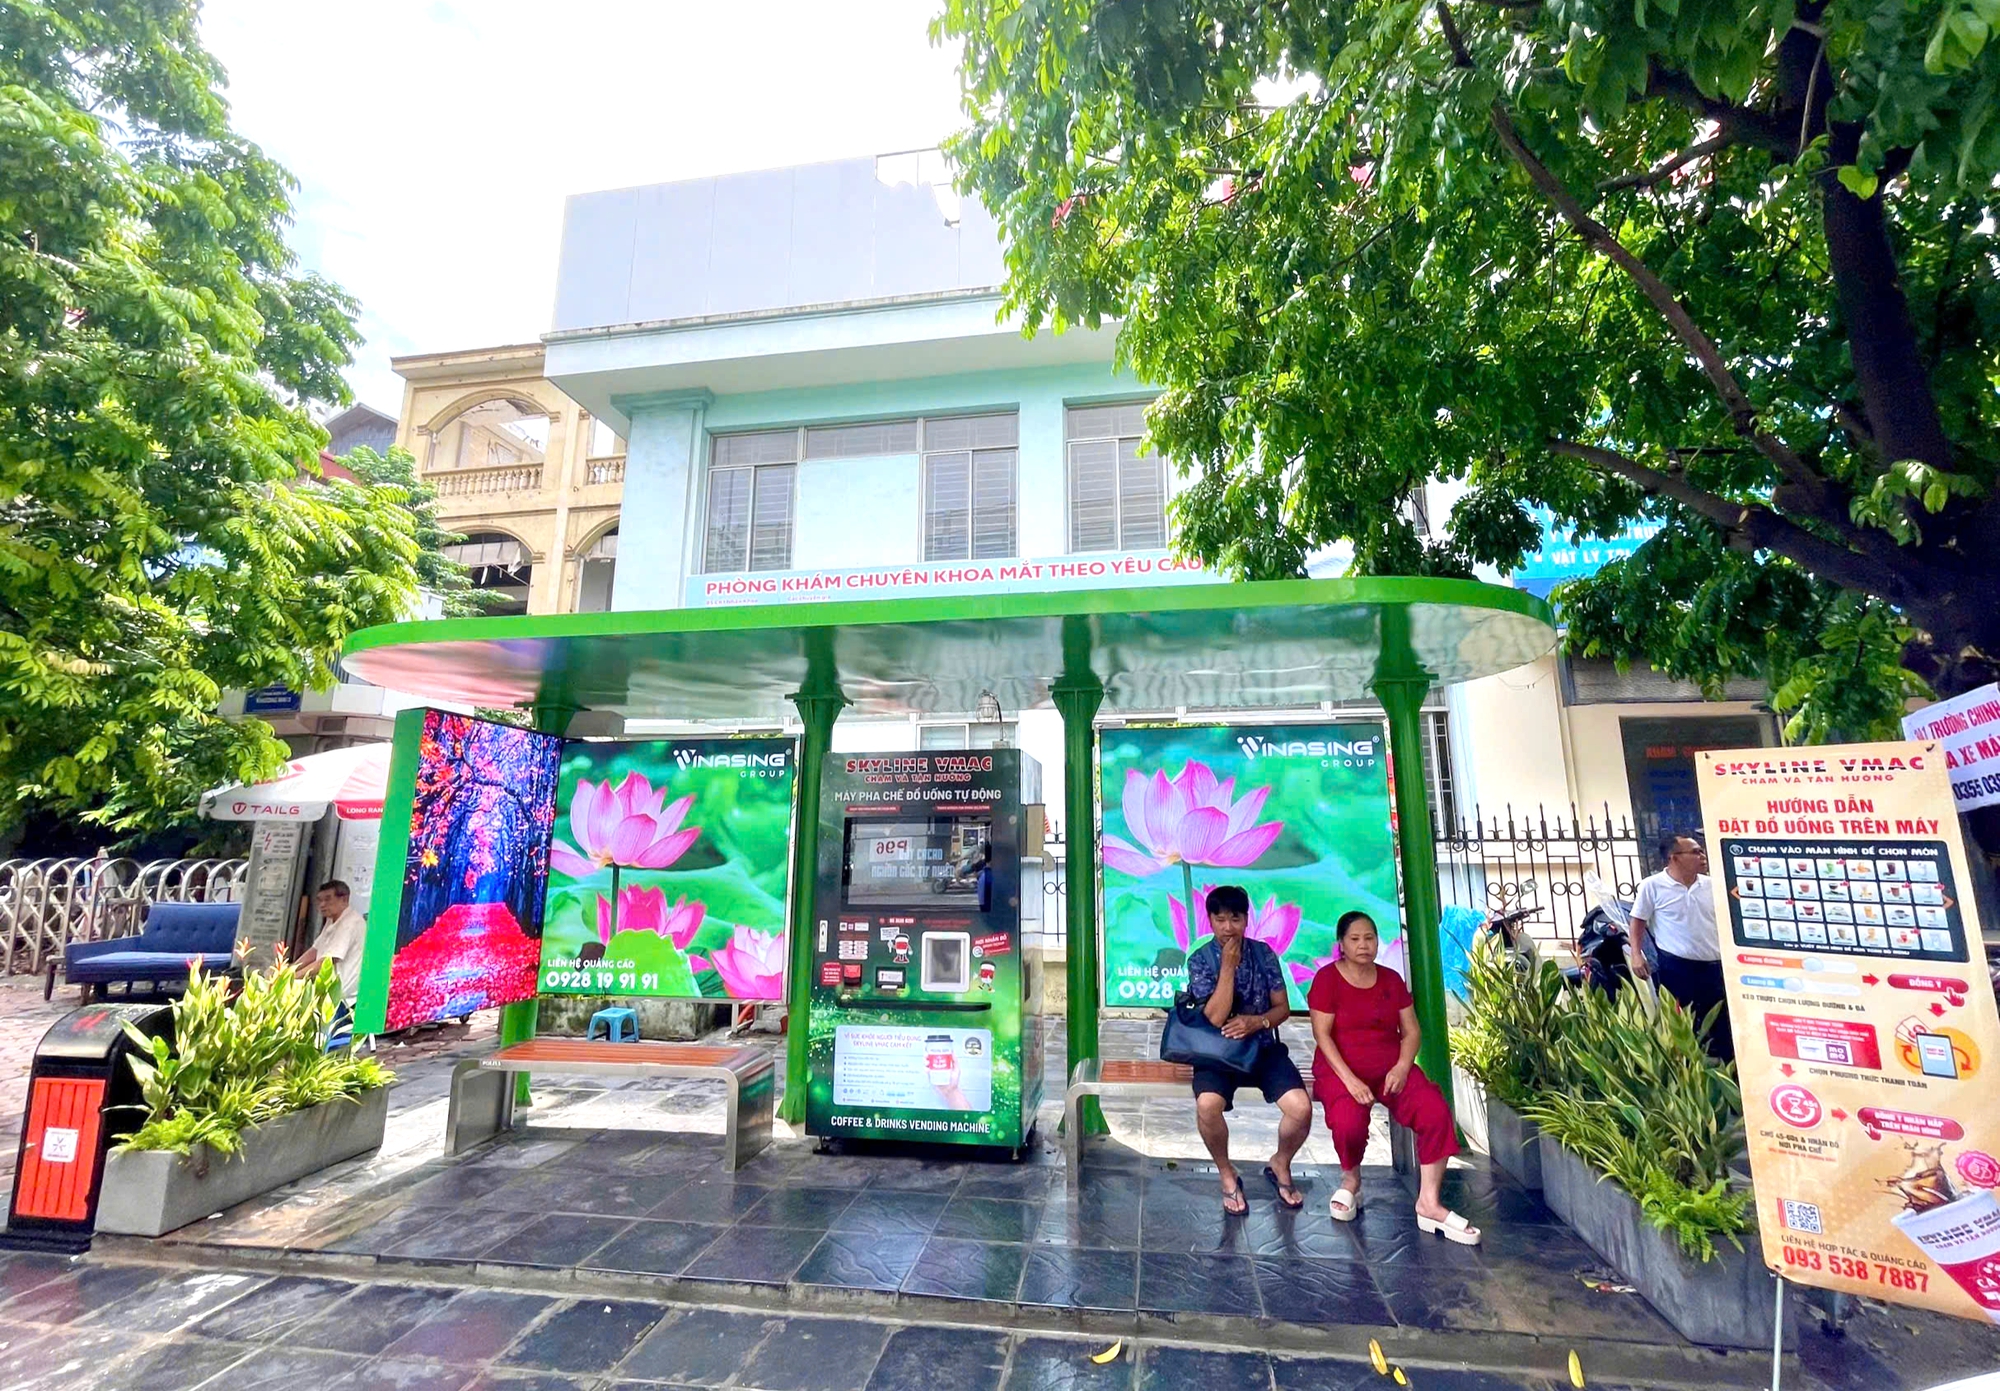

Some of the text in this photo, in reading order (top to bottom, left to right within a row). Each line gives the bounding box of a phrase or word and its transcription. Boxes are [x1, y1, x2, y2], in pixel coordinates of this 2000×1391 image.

[1552, 548, 1577, 567] VẬT
[1583, 547, 1600, 564] LÝ
[706, 578, 777, 595] PHÒNG
[782, 573, 841, 591] KHÁM
[846, 569, 928, 588] CHUYÊN
[934, 567, 994, 583] KHOA
[1000, 560, 1043, 580] MẮT
[1048, 562, 1106, 578] THEO
[1111, 557, 1152, 574] YÊU
[1928, 713, 1969, 740] TRƯỜNG
[846, 756, 993, 773] SKYLINE VMAC
[1321, 759, 1375, 768] GROUP
[1958, 745, 1977, 766] XE
[740, 769, 785, 778] GROUP
[1714, 757, 1924, 776] SKYLINE VMAC
[834, 789, 857, 801] MÁY
[858, 791, 881, 801] PHA
[883, 788, 905, 801] CHẾ
[923, 787, 953, 800] UỐNG
[954, 788, 970, 802] TỰ
[971, 788, 1002, 802] ĐỘNG
[1952, 778, 1984, 800] 0355
[251, 805, 300, 815] TAILG
[1767, 794, 1874, 814] HƯỚNG DẪN
[1718, 817, 1750, 836] ĐẶT
[1784, 815, 1835, 834] UỐNG
[1839, 818, 1889, 834] TRÊN
[1896, 815, 1940, 835] MÁY
[1748, 846, 1777, 855] CHẠM
[1780, 845, 1801, 854] VÀO
[1805, 845, 1831, 855] MÀN
[1878, 847, 1907, 856] CHỌN
[547, 957, 635, 969] LIÊN HỆ QUẢNG CÁO
[1118, 965, 1141, 977] LIÊN
[1144, 965, 1159, 978] HỆ
[546, 971, 658, 990] 0928 19 91 91
[1119, 980, 1174, 999] 0928
[1881, 1077, 1905, 1086] THANH
[831, 1116, 990, 1134] COFFEE & DRINKS VENDING MACHINE
[1781, 1234, 1802, 1246] LIÊN
[1840, 1246, 1859, 1258] TÁC
[1860, 1250, 1869, 1259] &
[1907, 1259, 1928, 1271] CÁO
[1783, 1245, 1929, 1293] 093 538 7887
